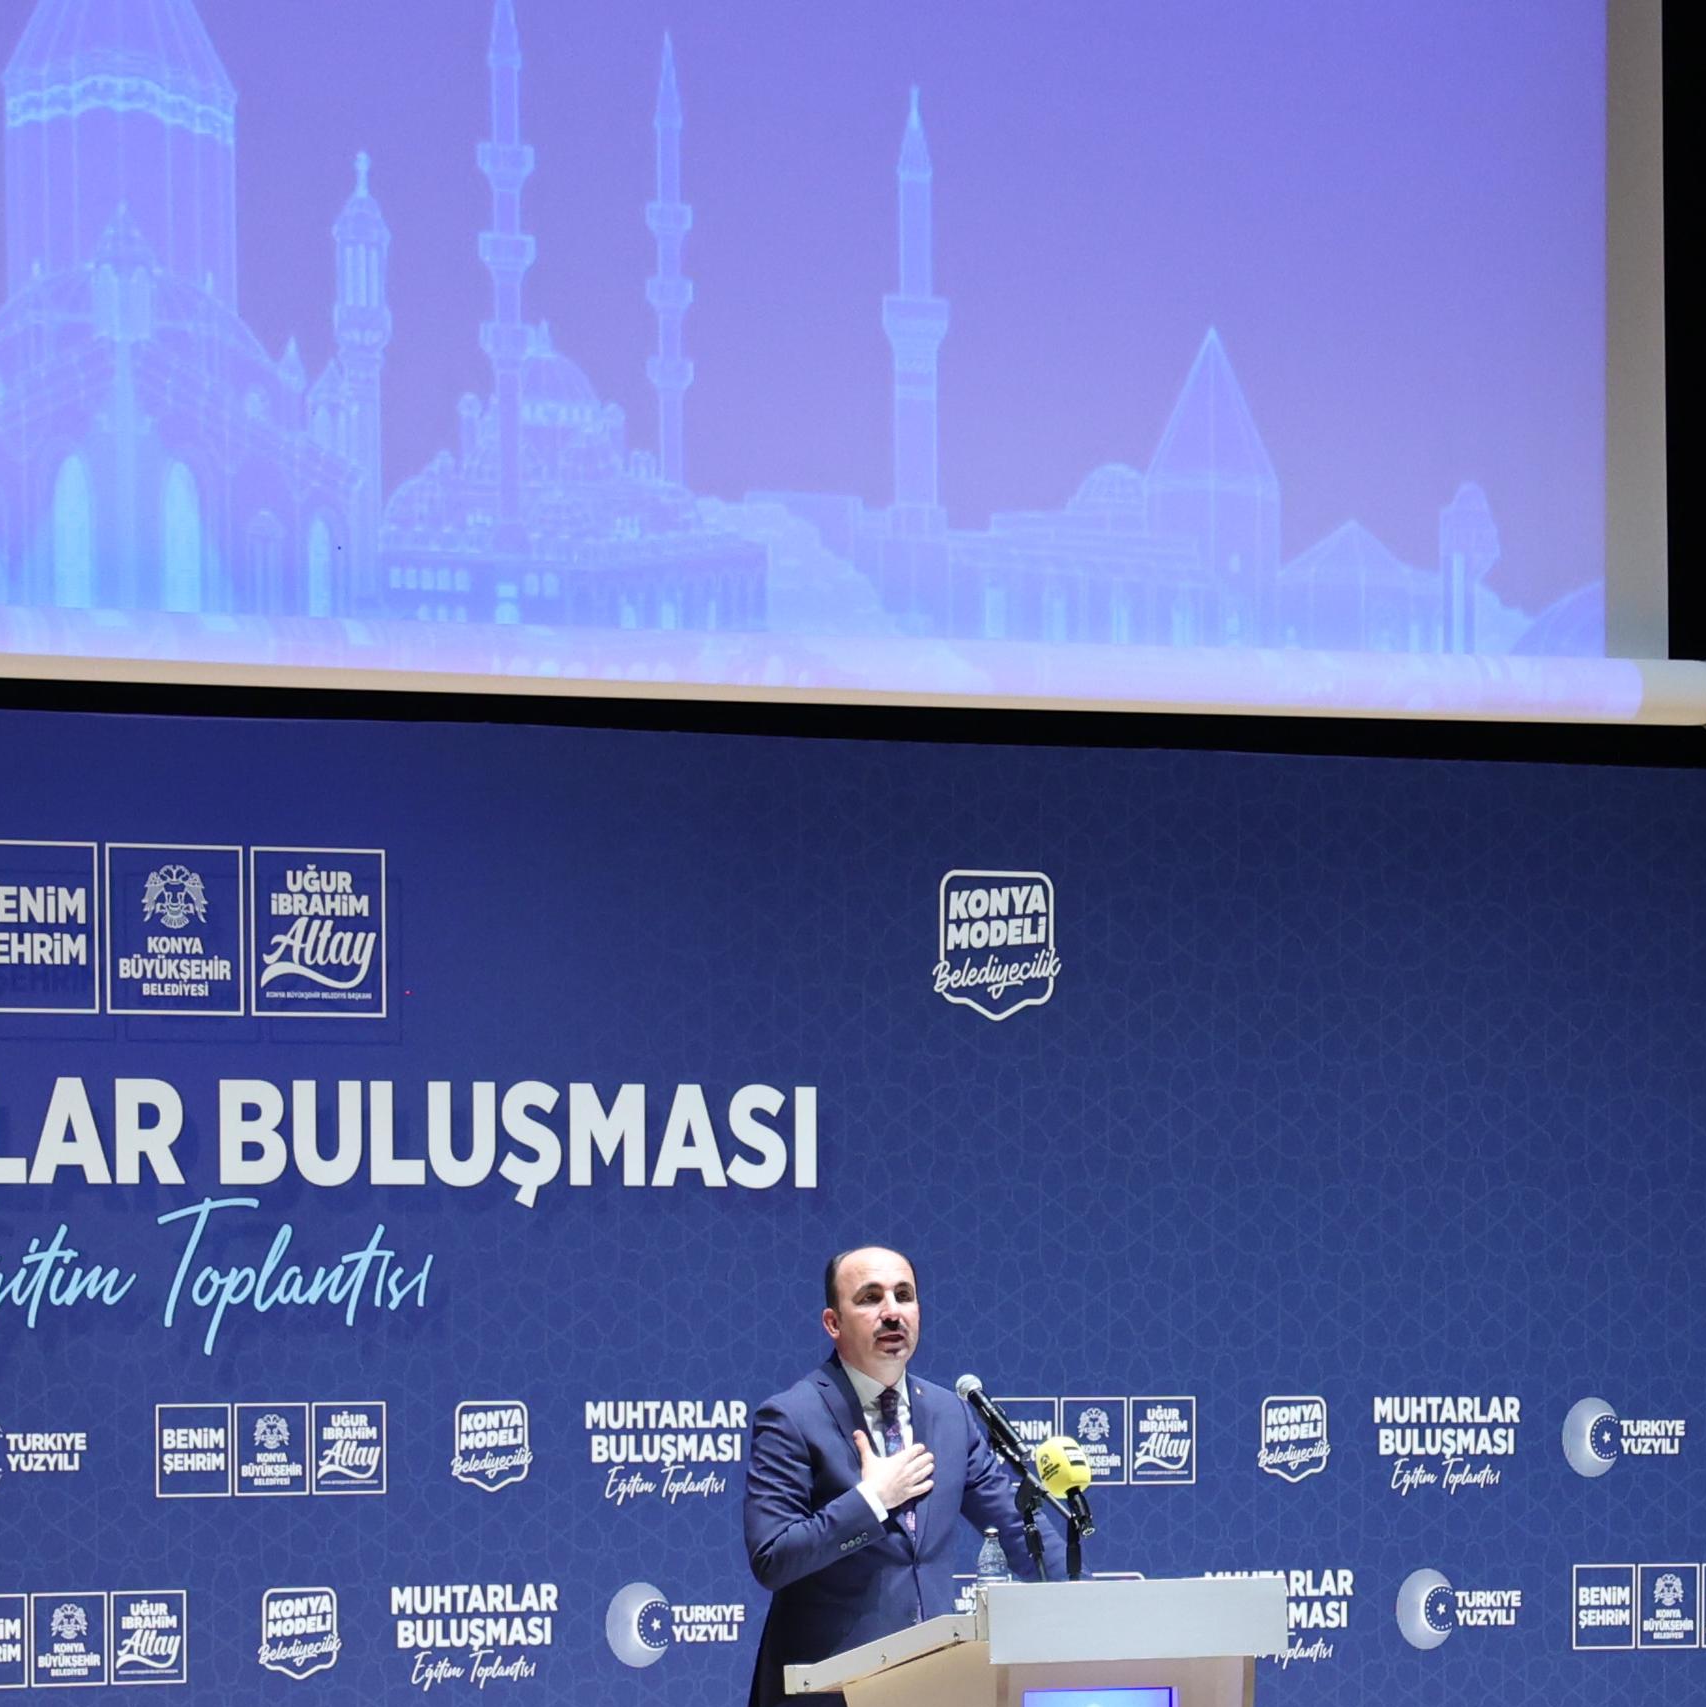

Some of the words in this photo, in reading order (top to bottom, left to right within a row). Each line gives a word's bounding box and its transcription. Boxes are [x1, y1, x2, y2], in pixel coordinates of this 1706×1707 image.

[287, 864, 352, 893] UĞUR
[271, 893, 368, 916] İBRAHİM
[949, 885, 1046, 920] KONYA
[148, 937, 203, 954] KONYA
[947, 917, 1046, 950] MODELİ
[119, 954, 231, 982] BÜYÜKŞEHİR
[261, 917, 376, 989] Altay
[932, 947, 1061, 999] Belediyecilik
[220, 1080, 816, 1207] BULUŞMASI
[158, 1198, 433, 1355] Toplantısı
[461, 1409, 523, 1432] KONYA
[586, 1401, 747, 1429] MUHTARLAR
[1374, 1397, 1520, 1423] MUHTARLAR
[459, 1427, 523, 1450] MODELİ
[592, 1434, 740, 1467] BULUŞMASI
[1380, 1428, 1514, 1460] BULUŞMASI
[451, 1446, 533, 1479] Belediyecilik
[1391, 1458, 1437, 1496] Eğitim
[605, 1466, 656, 1505] Eğitim
[130, 1600, 167, 1617] UĞUR
[392, 1584, 557, 1614] MUHTARLAR
[1579, 1586, 1630, 1605] BENİM
[122, 1615, 177, 1629] İBRAHİM
[398, 1617, 551, 1651] BULUŞMASI
[1579, 1609, 1630, 1628] ŞEHRİM
[54, 1643, 85, 1653] KONYA
[116, 1629, 181, 1669] Altay
[412, 1651, 464, 1691] Eğitim
